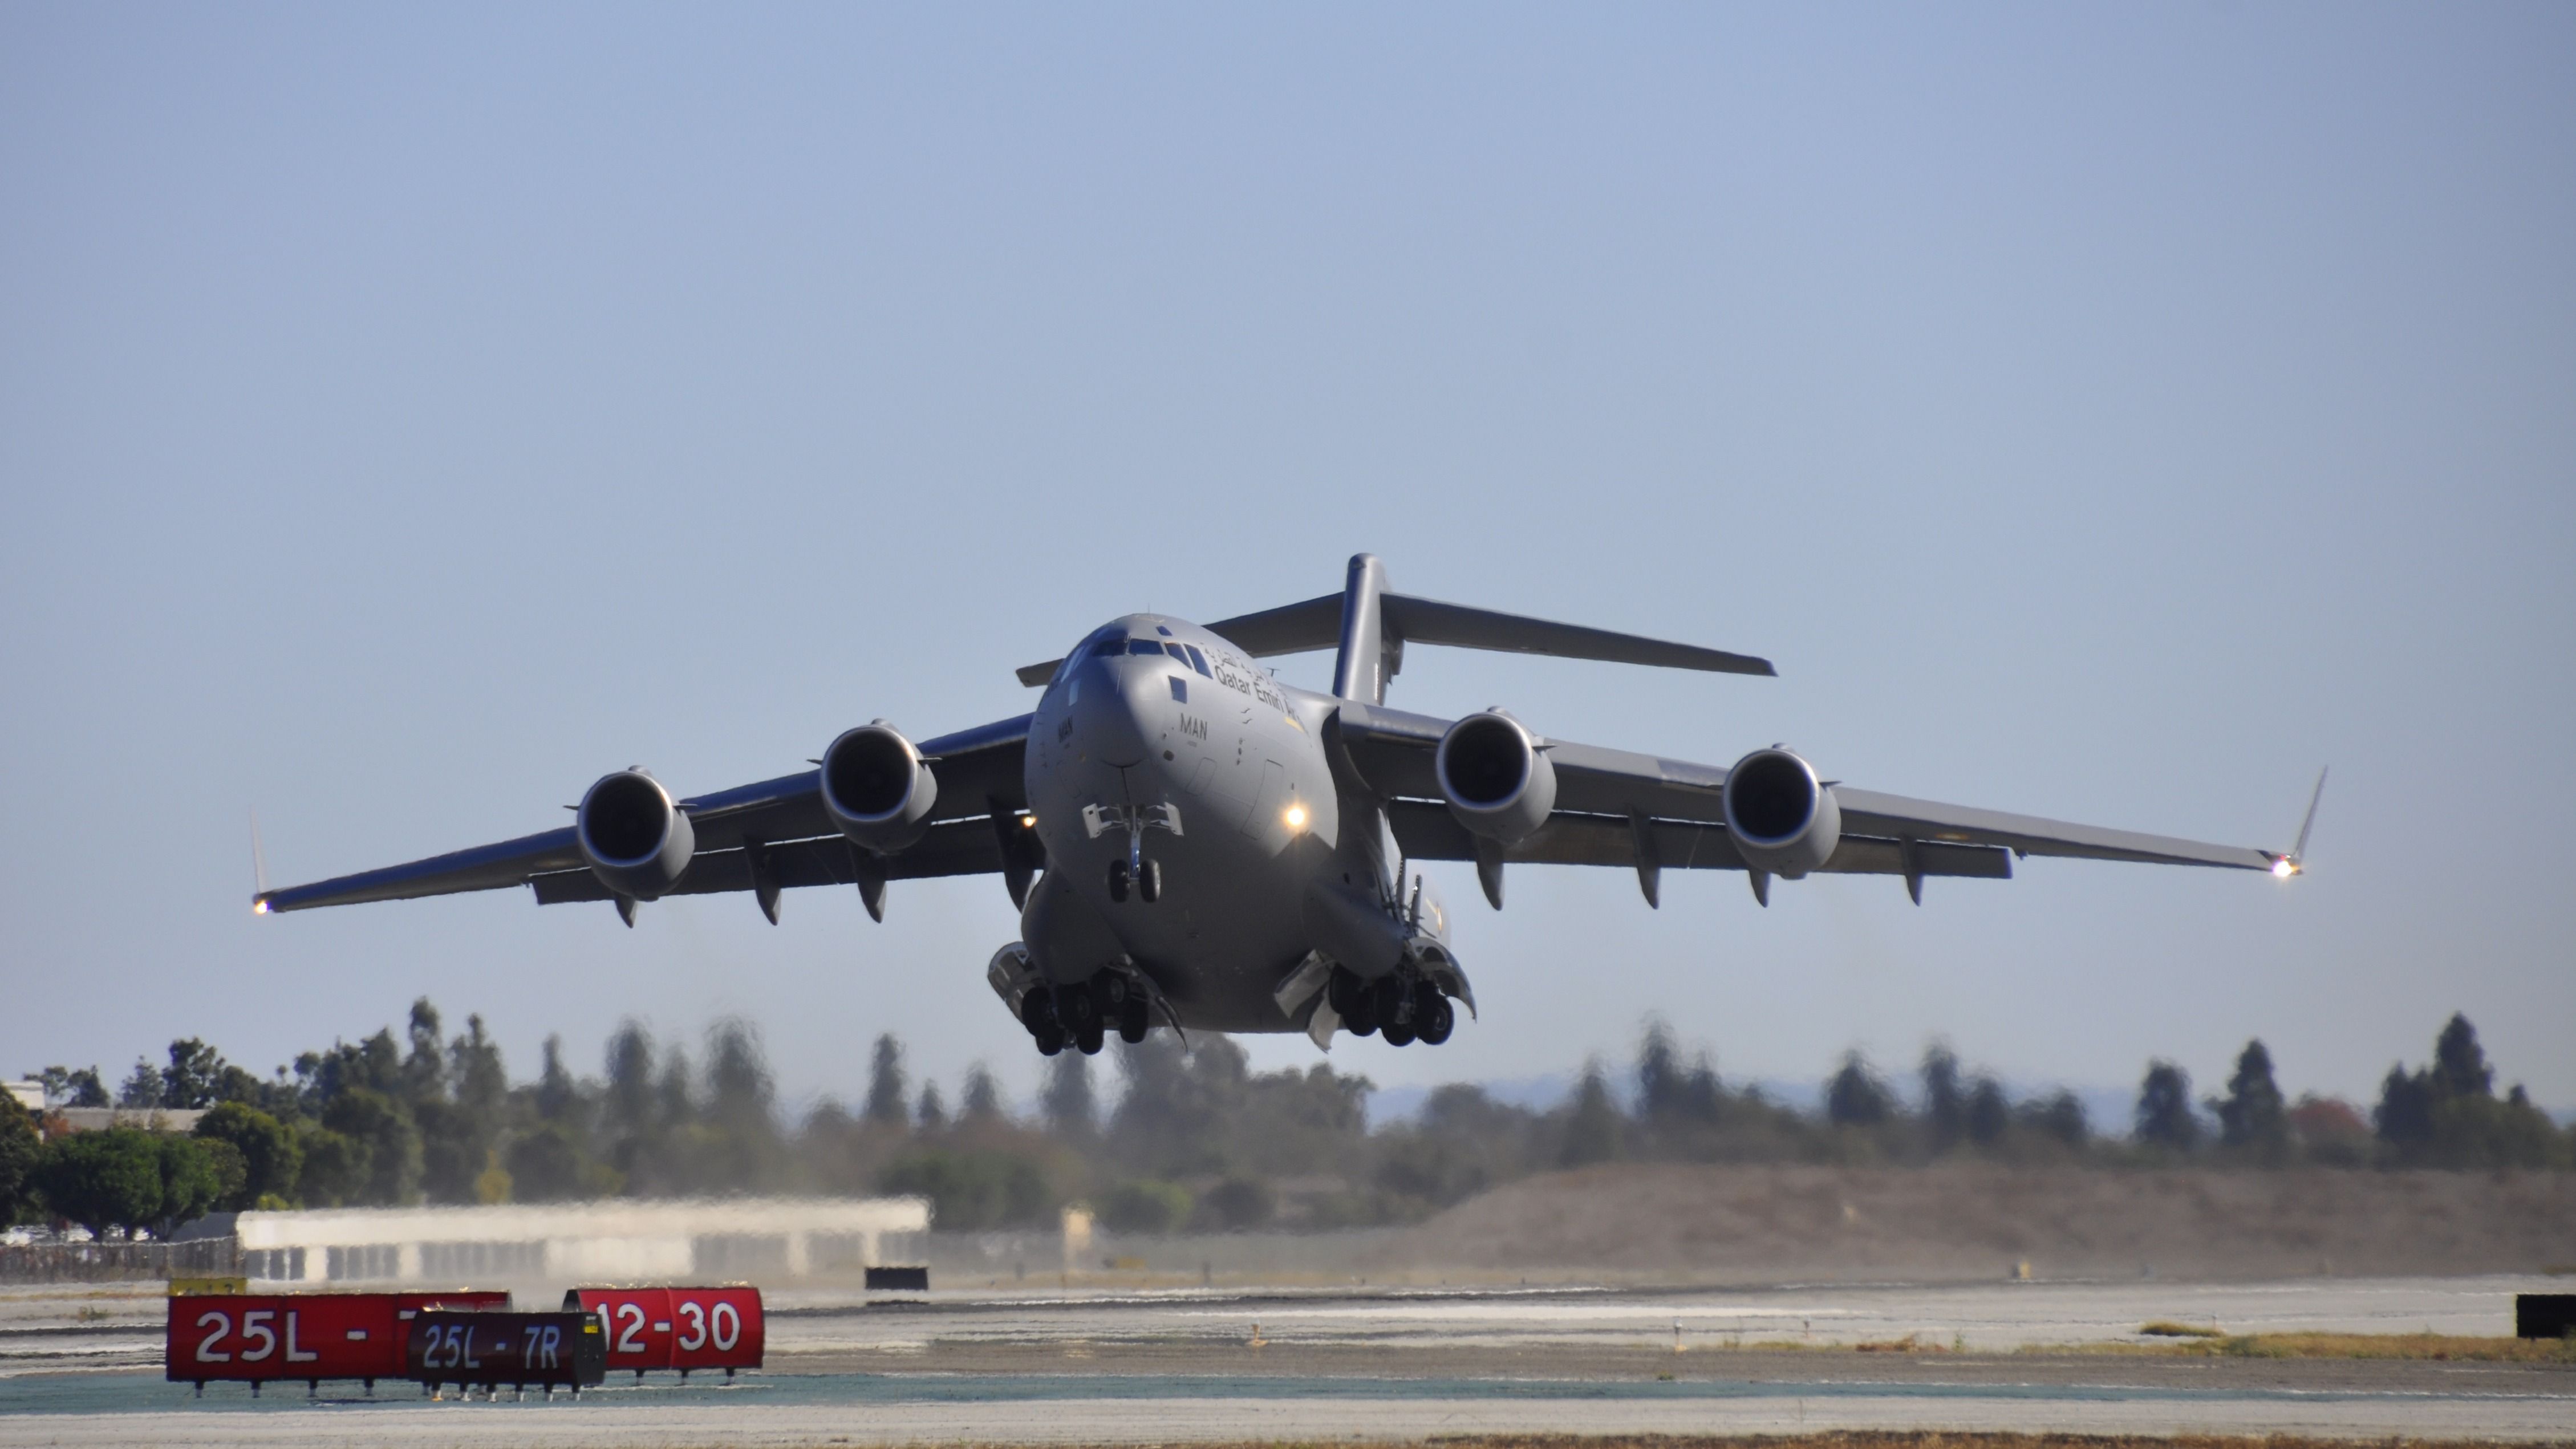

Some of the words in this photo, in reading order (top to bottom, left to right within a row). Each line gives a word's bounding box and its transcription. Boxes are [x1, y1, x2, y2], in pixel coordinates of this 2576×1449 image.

[1215, 665, 1251, 696] Qatar
[1253, 681, 1284, 713] Emiri
[1181, 712, 1207, 741] MAN
[196, 1311, 318, 1362] 25L
[424, 1325, 480, 1368] 25L
[525, 1325, 561, 1369] 7R
[597, 1302, 740, 1352] 12-30
